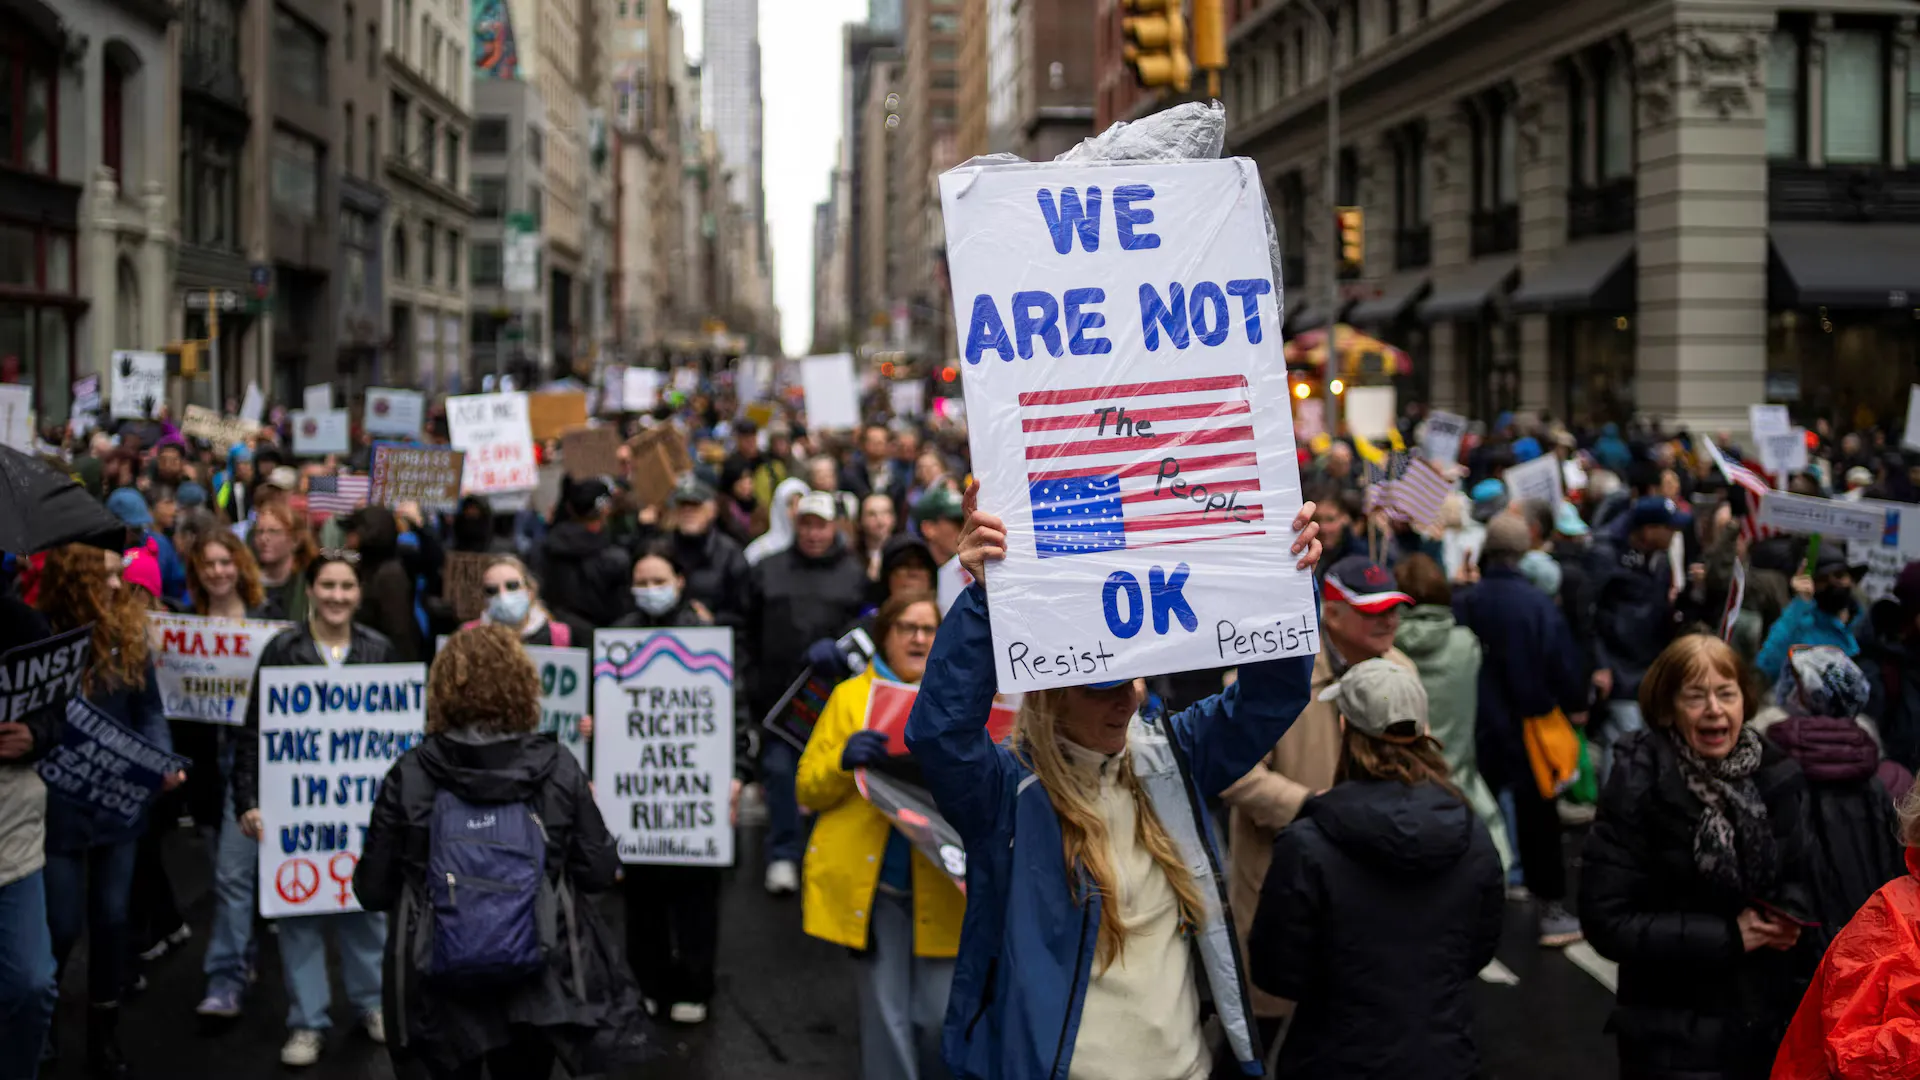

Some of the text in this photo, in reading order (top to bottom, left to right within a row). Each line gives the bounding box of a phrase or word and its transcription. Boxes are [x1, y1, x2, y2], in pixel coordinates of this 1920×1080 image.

[1037, 184, 1161, 254] WE
[965, 278, 1271, 365] ARE NOT
[1094, 407, 1155, 437] The
[1154, 457, 1250, 523] People
[1102, 562, 1198, 638] OK
[161, 628, 252, 658] MAKE
[1008, 615, 1314, 680] Resist Persist
[182, 676, 248, 697] THINK
[268, 684, 311, 715] NO
[314, 682, 361, 713] YOU
[624, 686, 714, 709] TRANS
[627, 711, 716, 738] RIGHTS
[76, 740, 130, 775] ARE
[262, 730, 321, 763] TAKE
[329, 729, 364, 763] MY
[640, 744, 697, 769] ARE
[89, 783, 141, 816] YOU
[291, 774, 328, 807] I'M
[615, 773, 711, 797] HUMAN
[630, 801, 716, 831] RIGHTS
[280, 822, 348, 853] USING
